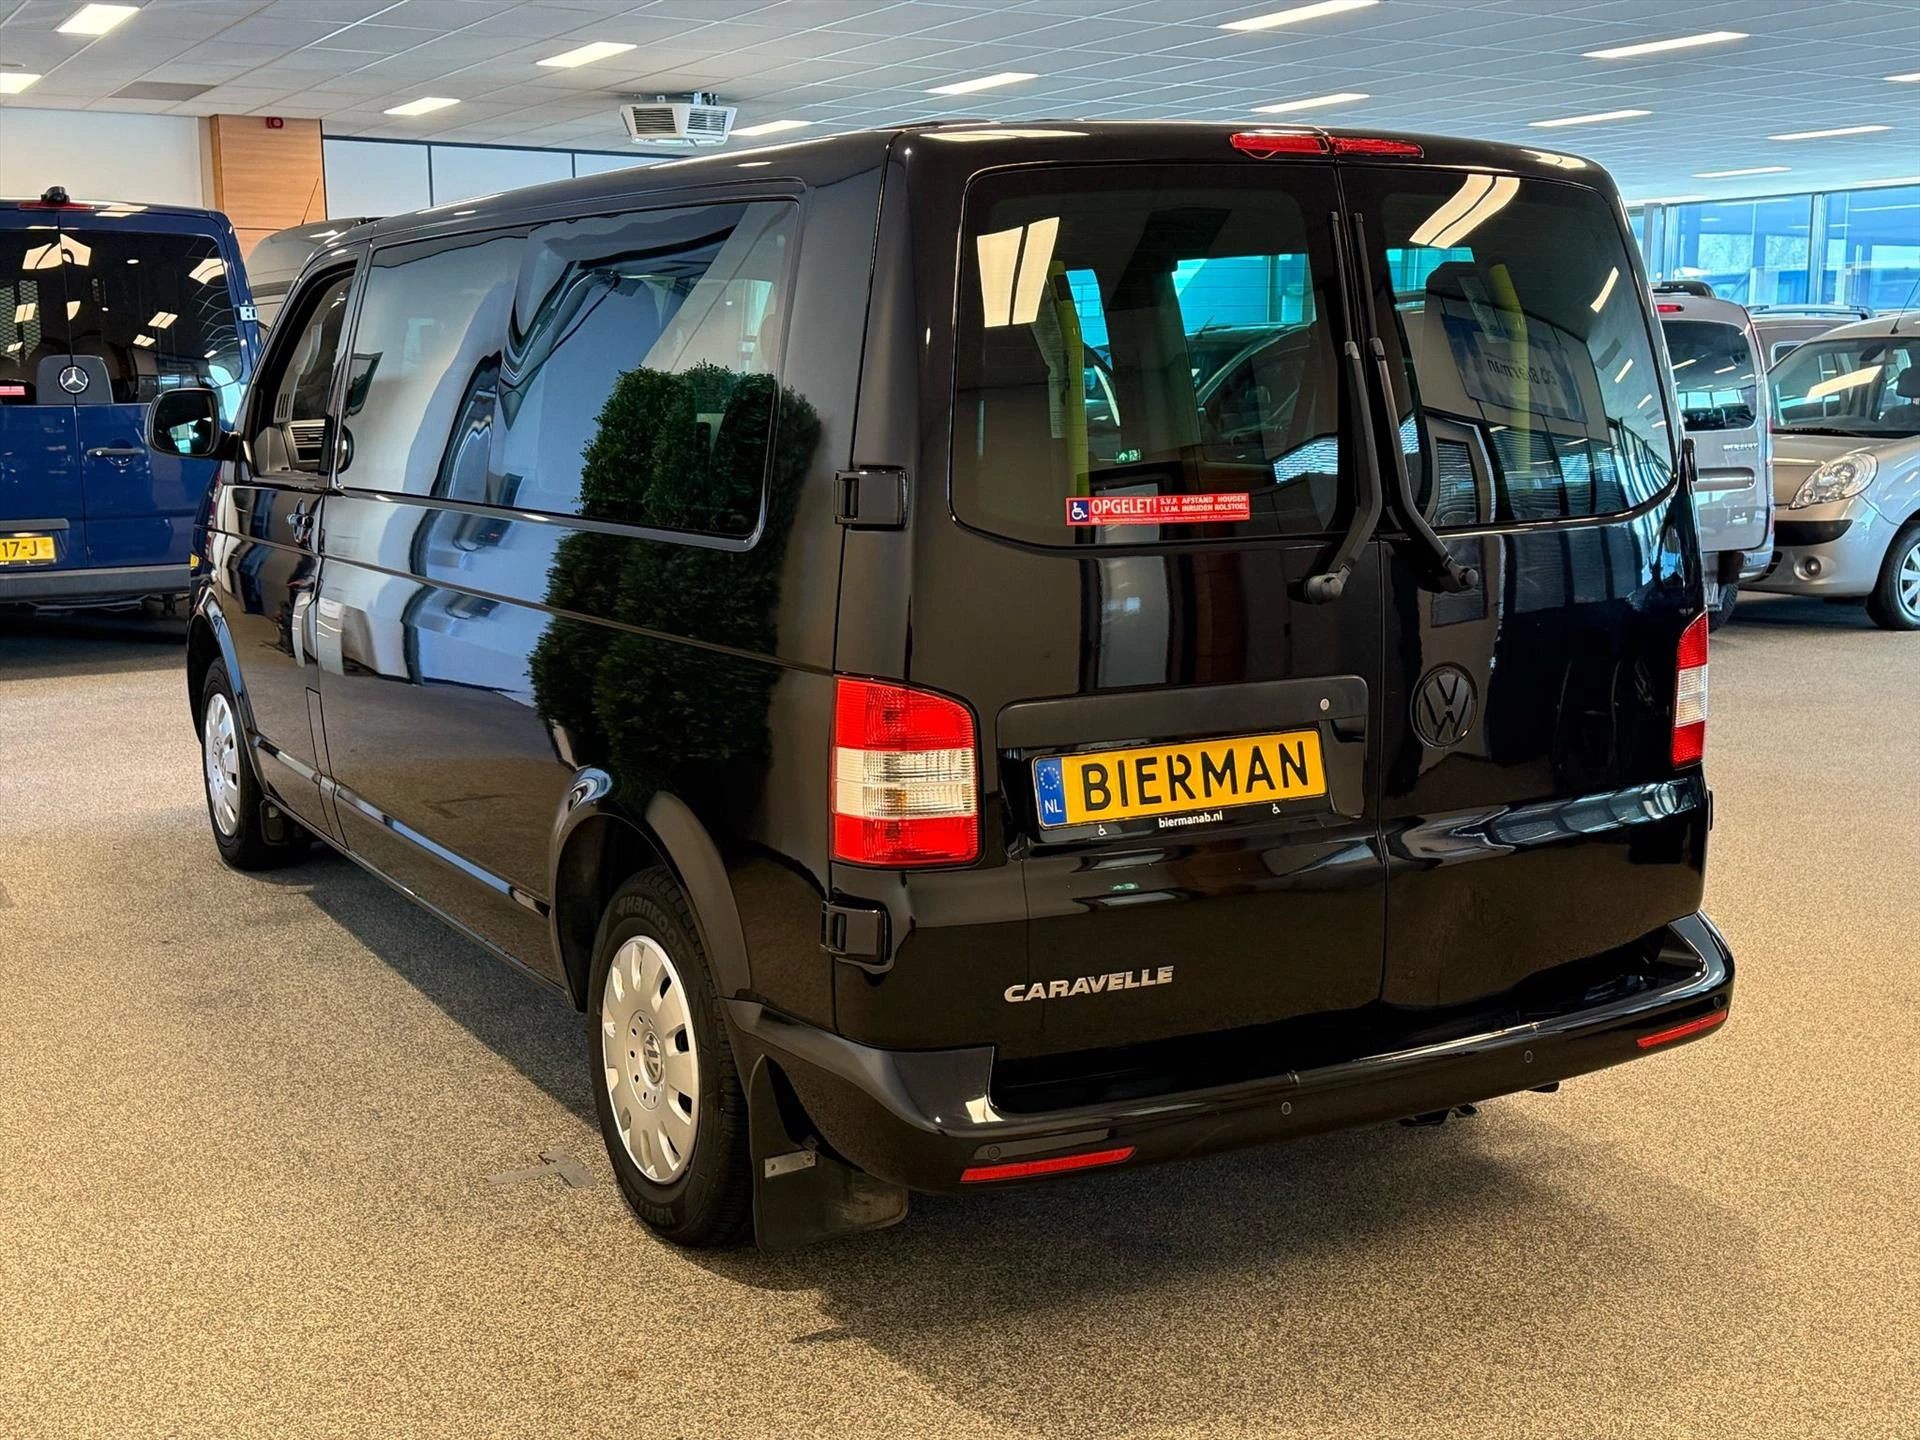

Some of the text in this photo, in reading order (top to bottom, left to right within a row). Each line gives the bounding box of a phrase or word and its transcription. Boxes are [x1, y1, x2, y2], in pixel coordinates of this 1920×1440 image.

[1091, 498, 1157, 514] OPGELET!
[1181, 496, 1214, 504] AFSTAND
[1217, 495, 1247, 503] HOUDEN
[1214, 503, 1248, 511] ROLSTOEL
[1081, 741, 1308, 811] BIERMAN
[1044, 798, 1063, 815] NL
[1158, 810, 1223, 829] biermanab.nl
[1003, 965, 1174, 1003] CARAVELLE
